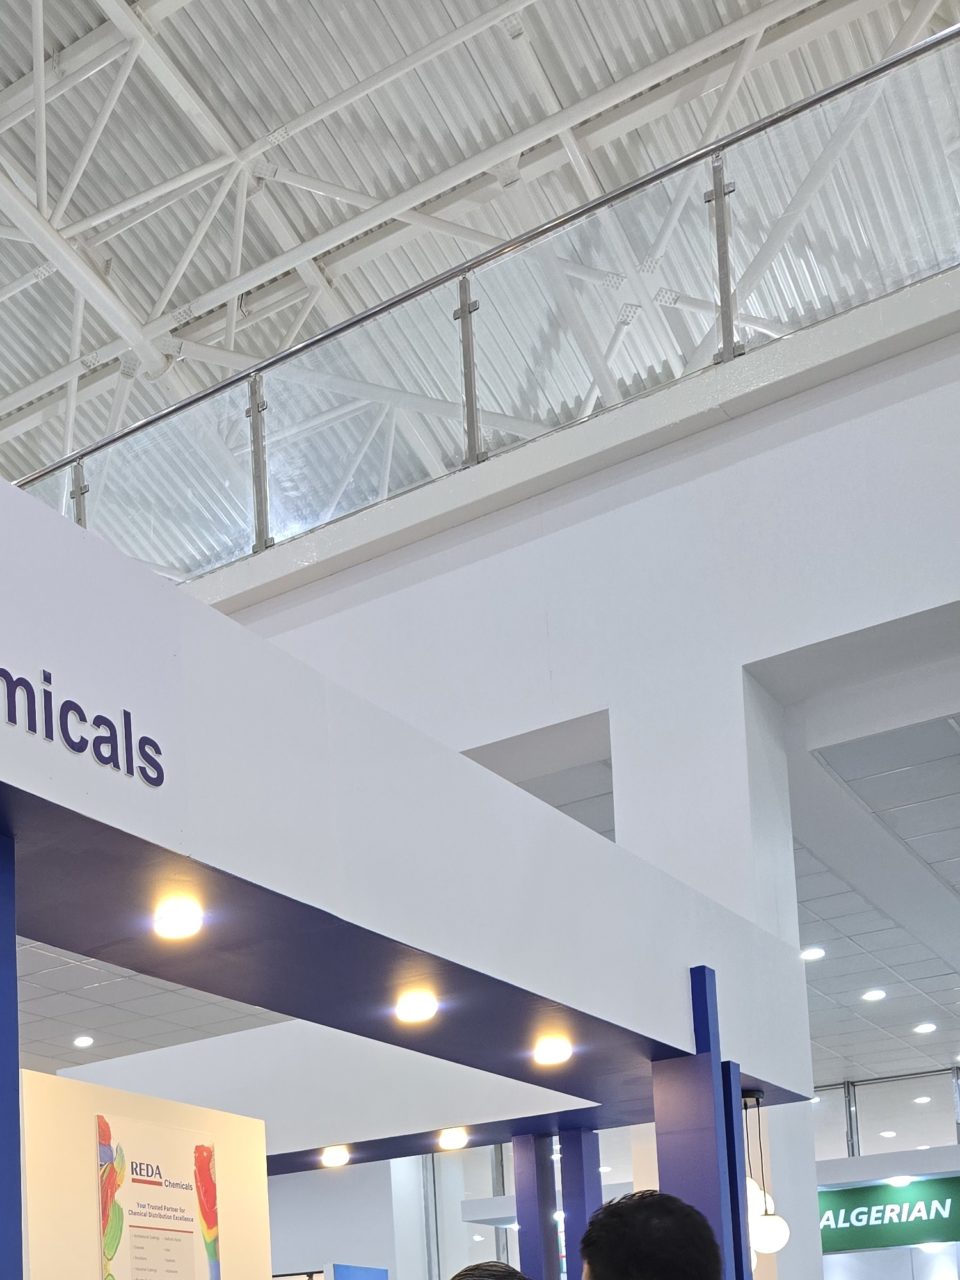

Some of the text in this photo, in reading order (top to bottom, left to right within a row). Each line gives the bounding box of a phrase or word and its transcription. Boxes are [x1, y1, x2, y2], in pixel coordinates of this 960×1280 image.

[130, 1160, 162, 1180] REDA
[164, 1179, 194, 1191] Chemicals
[820, 1198, 952, 1230] ALGERIAN
